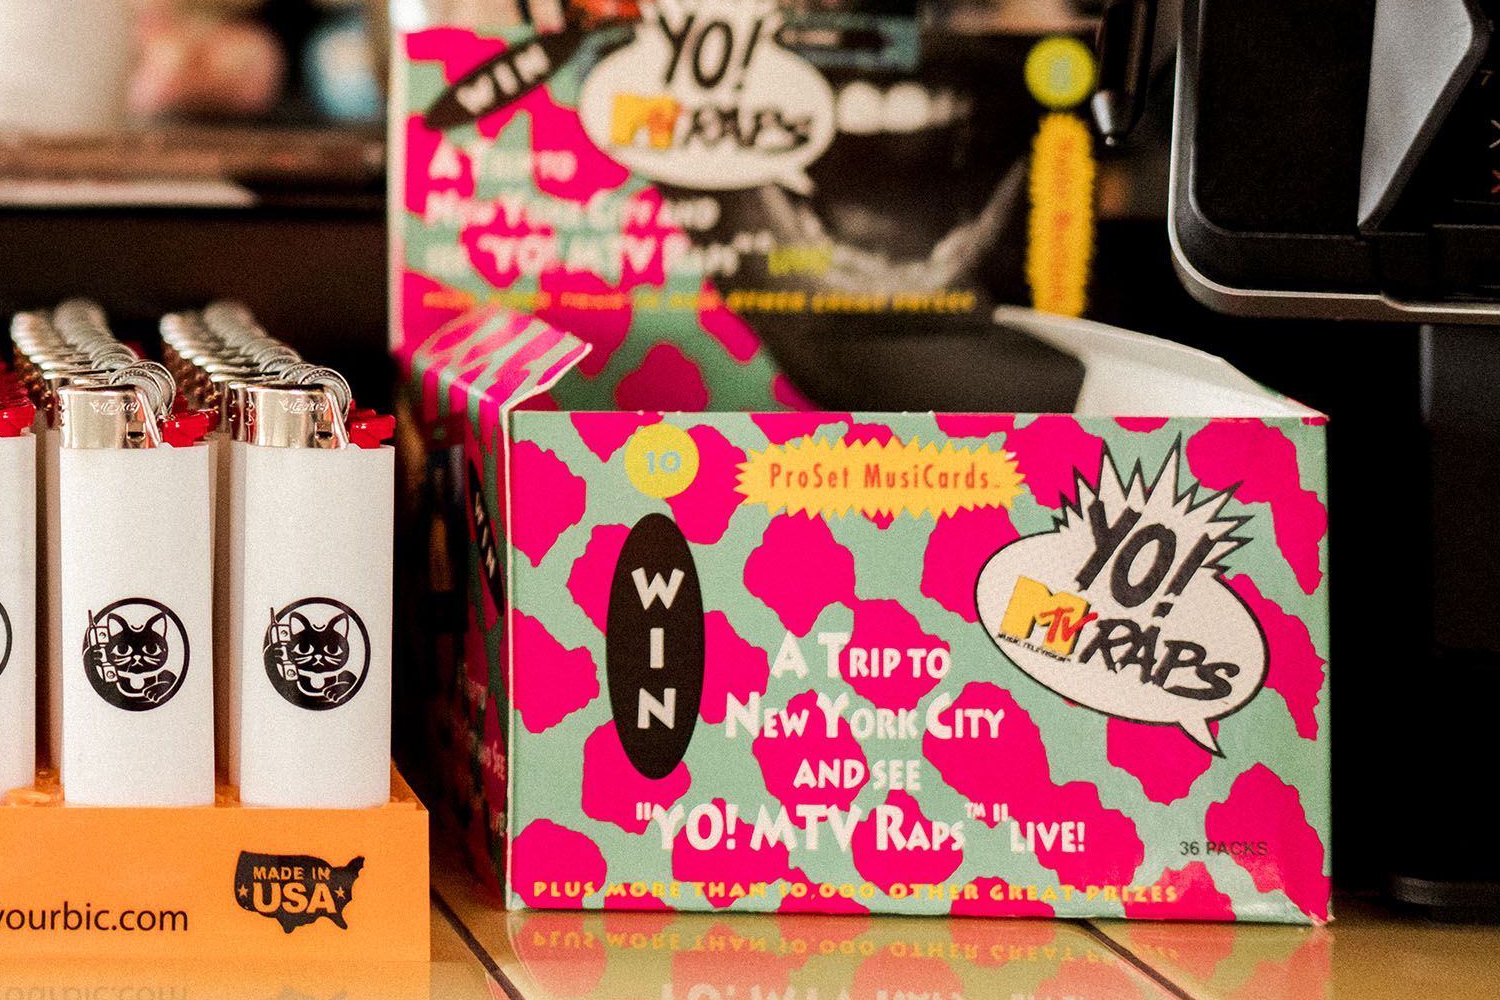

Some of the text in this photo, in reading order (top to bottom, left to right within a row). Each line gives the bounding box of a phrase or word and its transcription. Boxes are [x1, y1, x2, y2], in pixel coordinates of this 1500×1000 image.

[659, 14, 763, 91] YO!
[456, 42, 550, 115] WIN
[645, 449, 682, 474] 10
[769, 463, 849, 489] ProSet
[1075, 499, 1219, 618] YO!
[631, 566, 685, 730] WIN
[770, 630, 809, 679] A
[906, 647, 951, 679] TO
[999, 575, 1241, 701] MTV RAPS
[793, 758, 922, 791] AND SEE
[749, 803, 863, 851] MTV
[1179, 840, 1269, 857] 36 PACKS
[252, 865, 331, 881] MADE IN
[533, 880, 595, 898] PLUS
[605, 881, 680, 898] MORE
[692, 881, 767, 899] THAN
[888, 883, 980, 901] OTHER
[990, 884, 1074, 902] GREAT
[1087, 885, 1178, 903] PRIZES
[252, 882, 337, 914] USA
